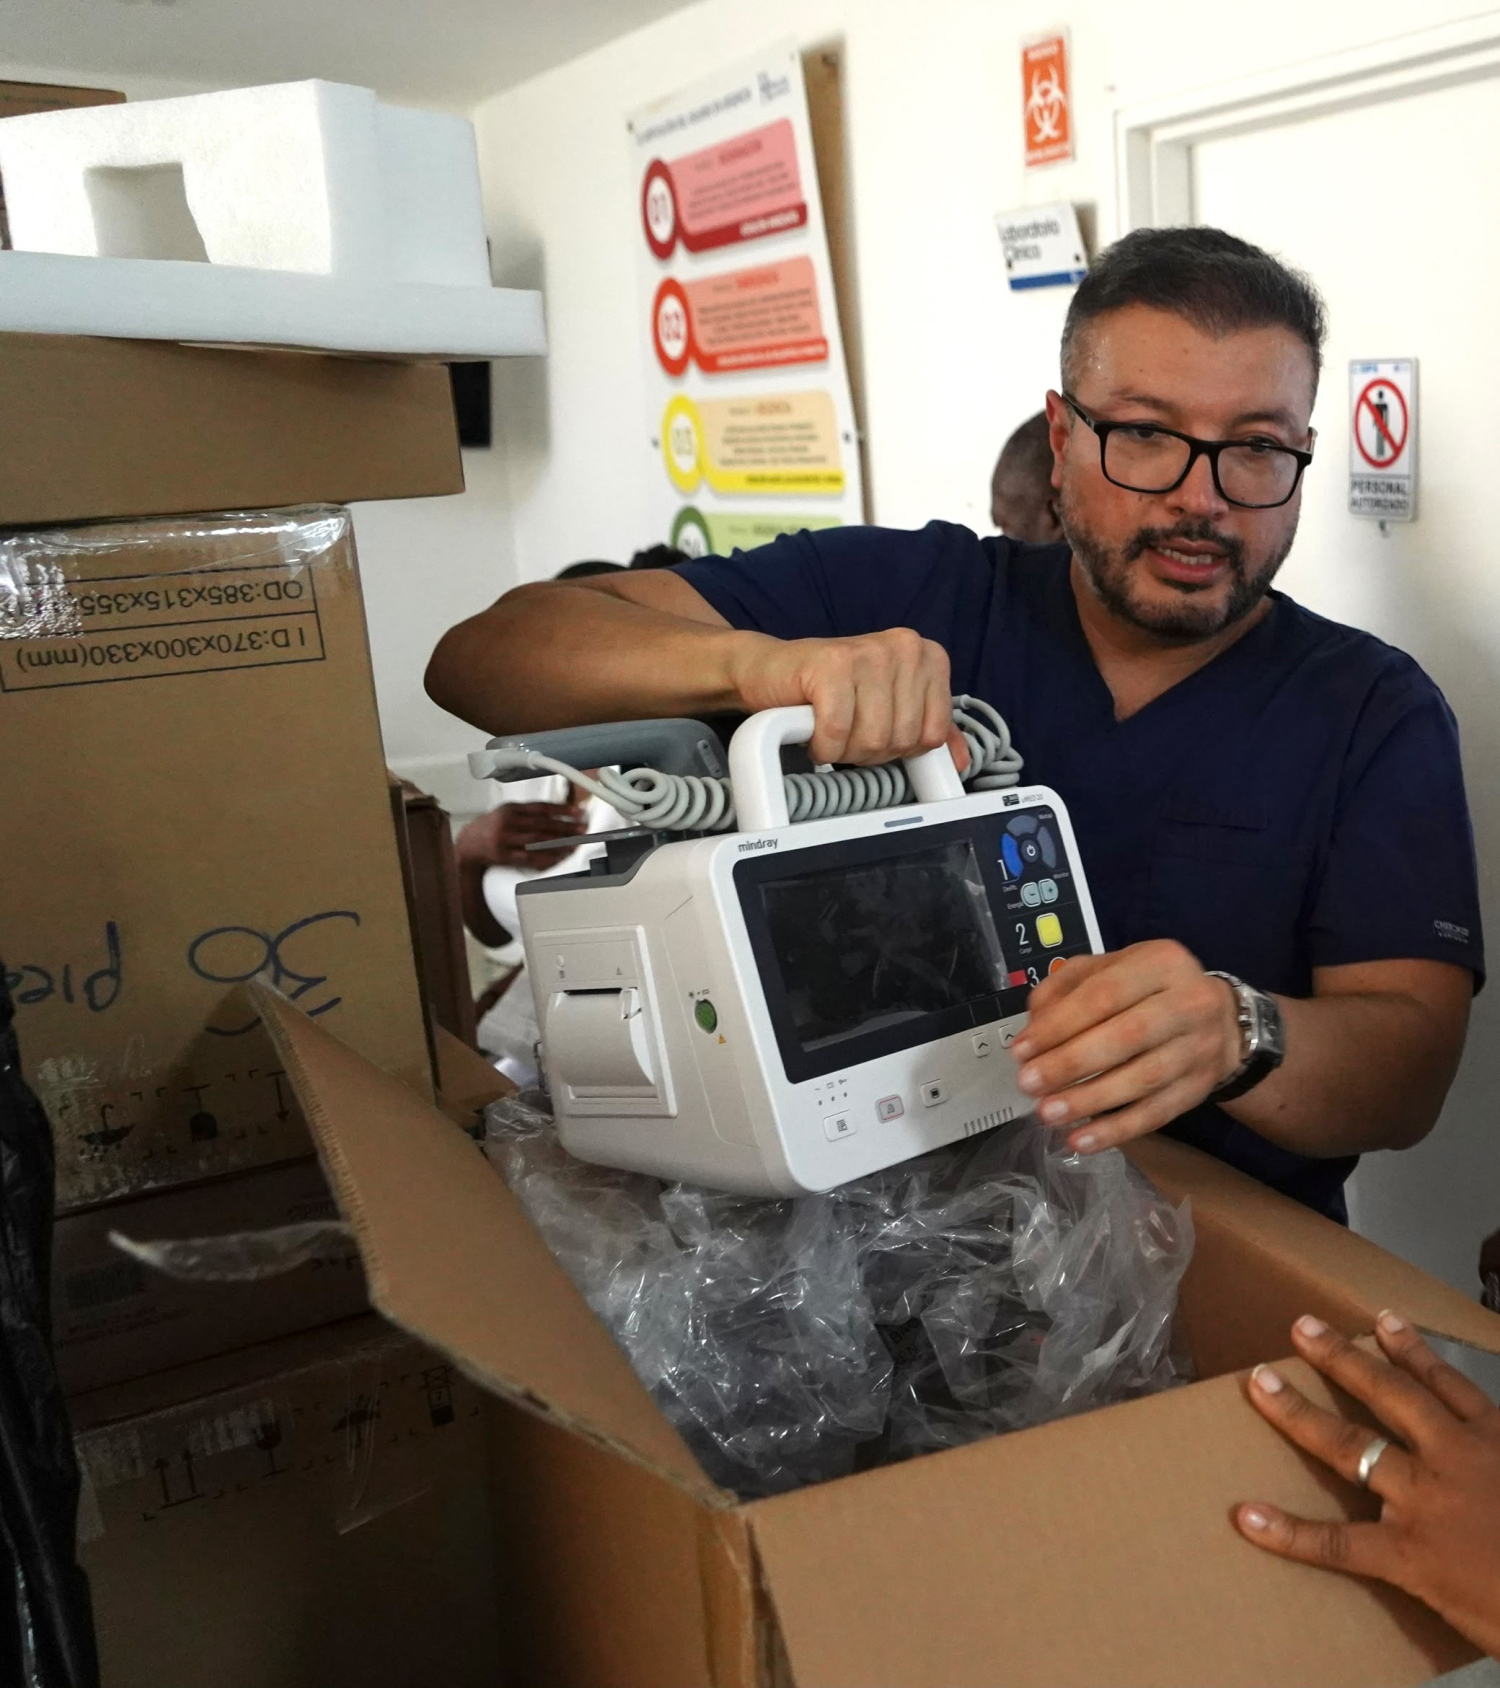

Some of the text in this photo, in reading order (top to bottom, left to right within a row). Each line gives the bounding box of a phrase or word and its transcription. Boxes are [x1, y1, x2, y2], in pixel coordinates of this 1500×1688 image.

[738, 839, 778, 852] mindray
[997, 859, 1008, 880] 1
[1015, 923, 1029, 945] 2
[1027, 966, 1040, 988] 3
